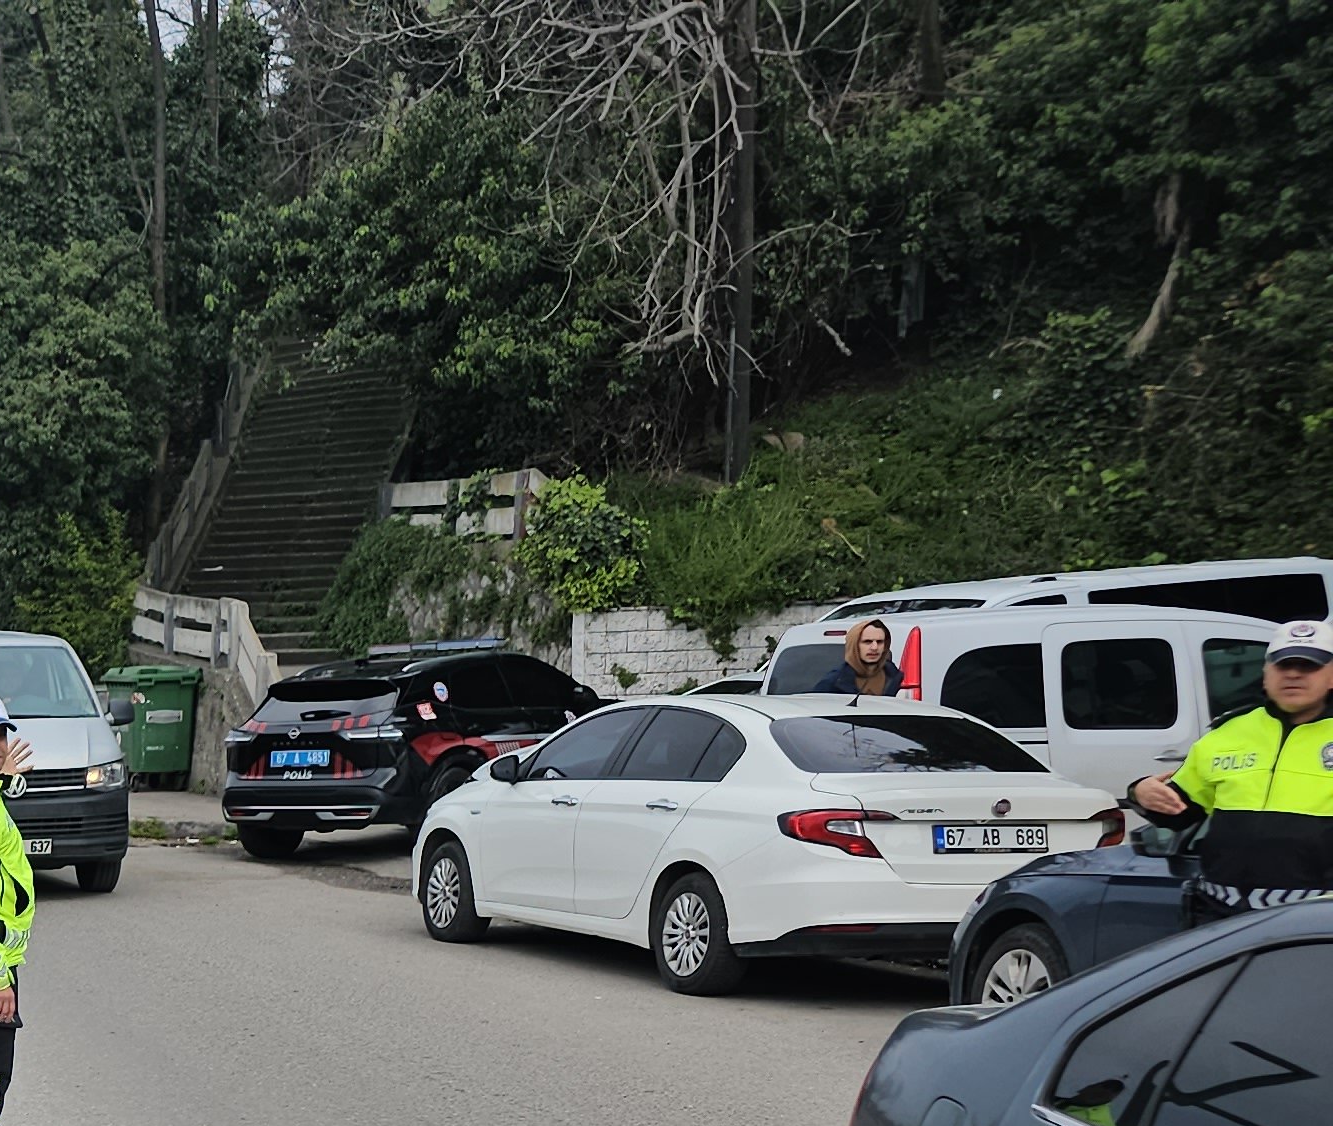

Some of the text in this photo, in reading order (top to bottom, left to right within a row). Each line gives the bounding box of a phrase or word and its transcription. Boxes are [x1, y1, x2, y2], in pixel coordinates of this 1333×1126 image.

[276, 753, 288, 764] 67
[294, 753, 300, 764] A
[946, 829, 965, 846] 67
[982, 829, 1001, 846] AB
[1016, 829, 1045, 846] 689
[30, 840, 51, 853] 637
